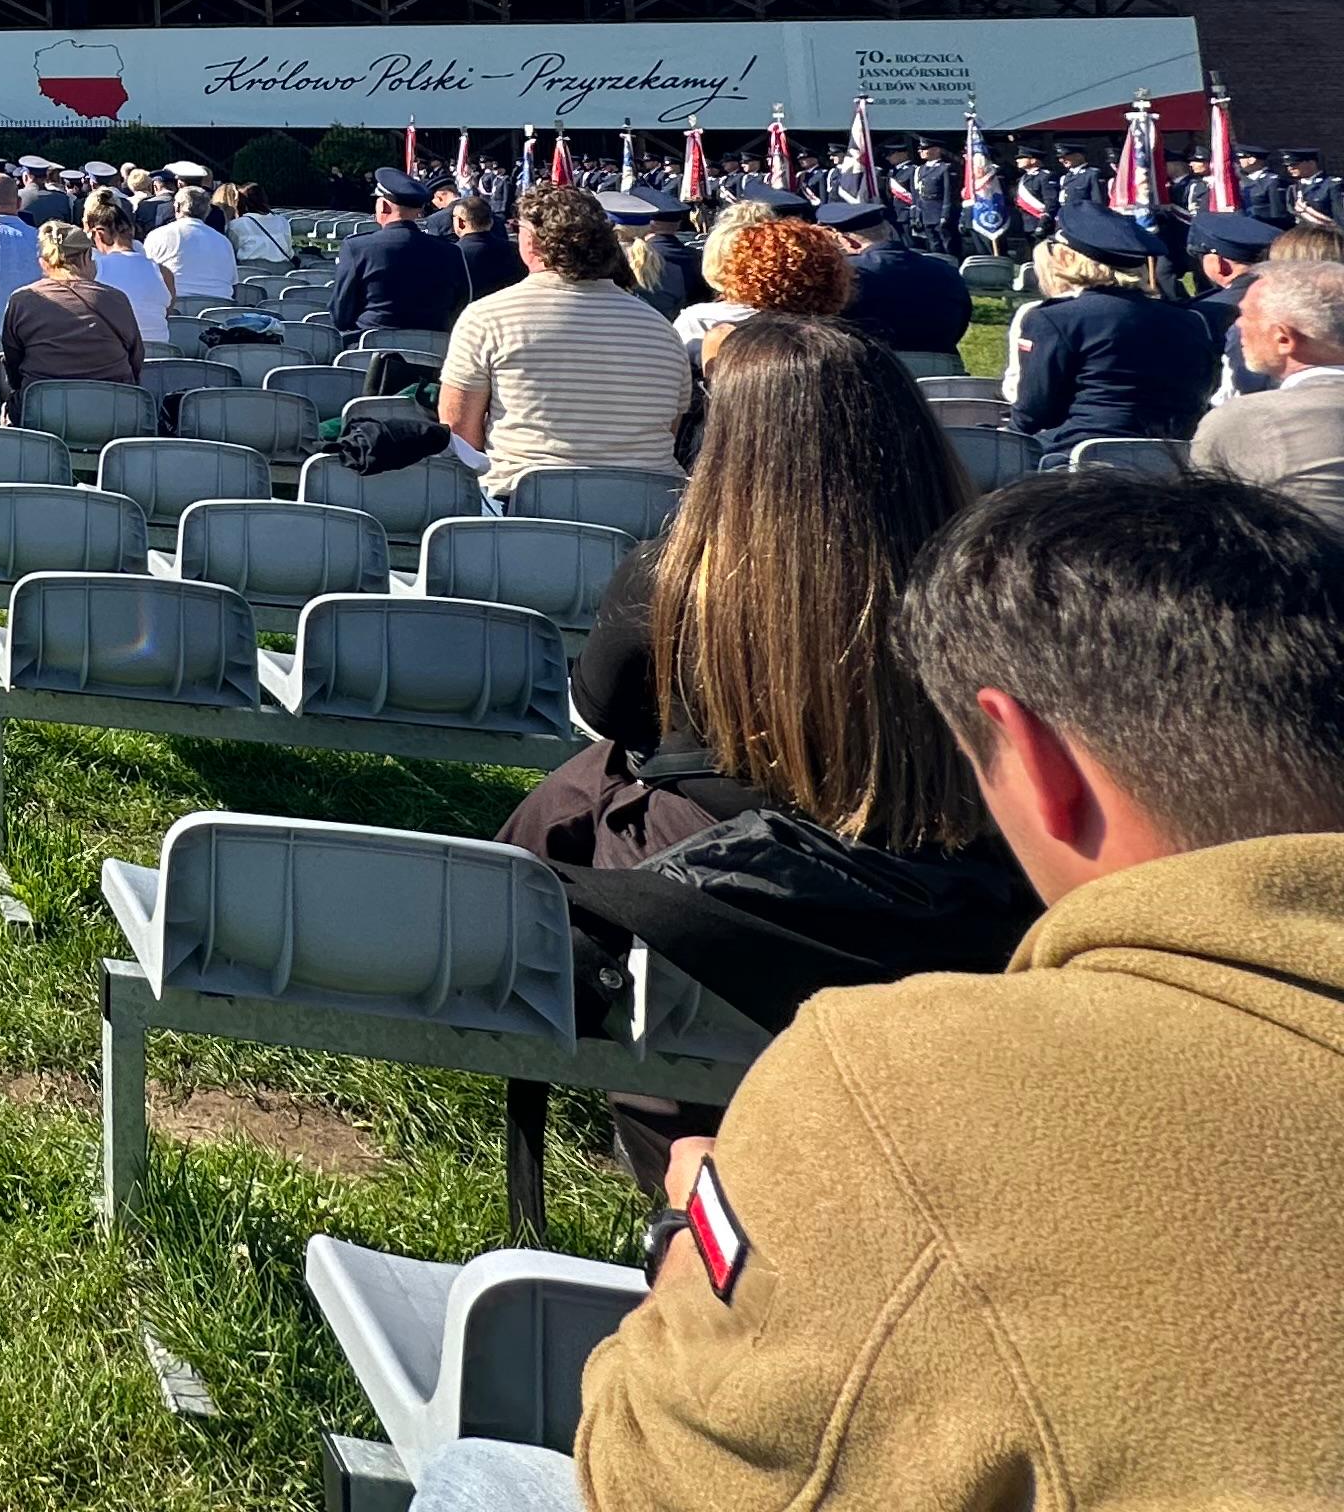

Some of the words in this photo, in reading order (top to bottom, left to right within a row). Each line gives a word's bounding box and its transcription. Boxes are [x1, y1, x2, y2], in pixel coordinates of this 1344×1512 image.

[855, 50, 892, 66] 70.
[895, 53, 964, 64] ROCZNICA
[858, 66, 970, 79] JASNOGÓRSKICH
[204, 55, 367, 95] Królowo
[366, 53, 474, 97] Polski
[517, 52, 758, 123] Przyrzekamy!
[860, 80, 917, 92] ŚLUBÓW
[919, 81, 976, 92] NARODU
